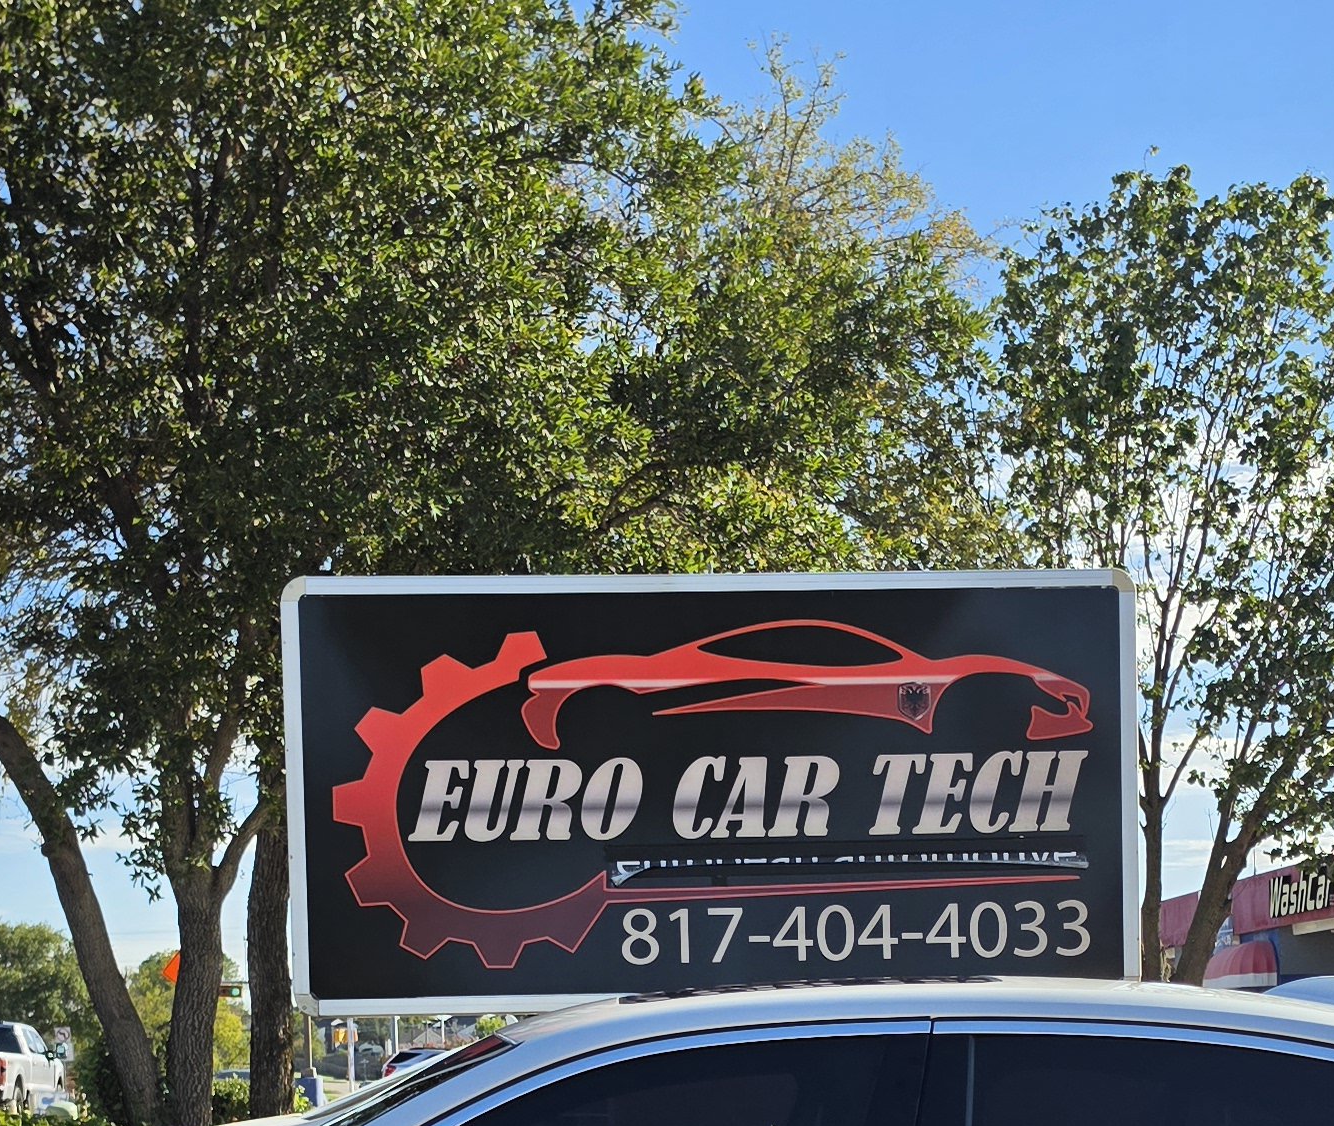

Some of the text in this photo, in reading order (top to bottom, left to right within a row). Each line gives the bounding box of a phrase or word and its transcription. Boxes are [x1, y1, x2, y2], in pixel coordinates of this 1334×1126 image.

[408, 750, 1089, 842] EURO CAR TECH
[621, 899, 1091, 966] 817-404-4033
